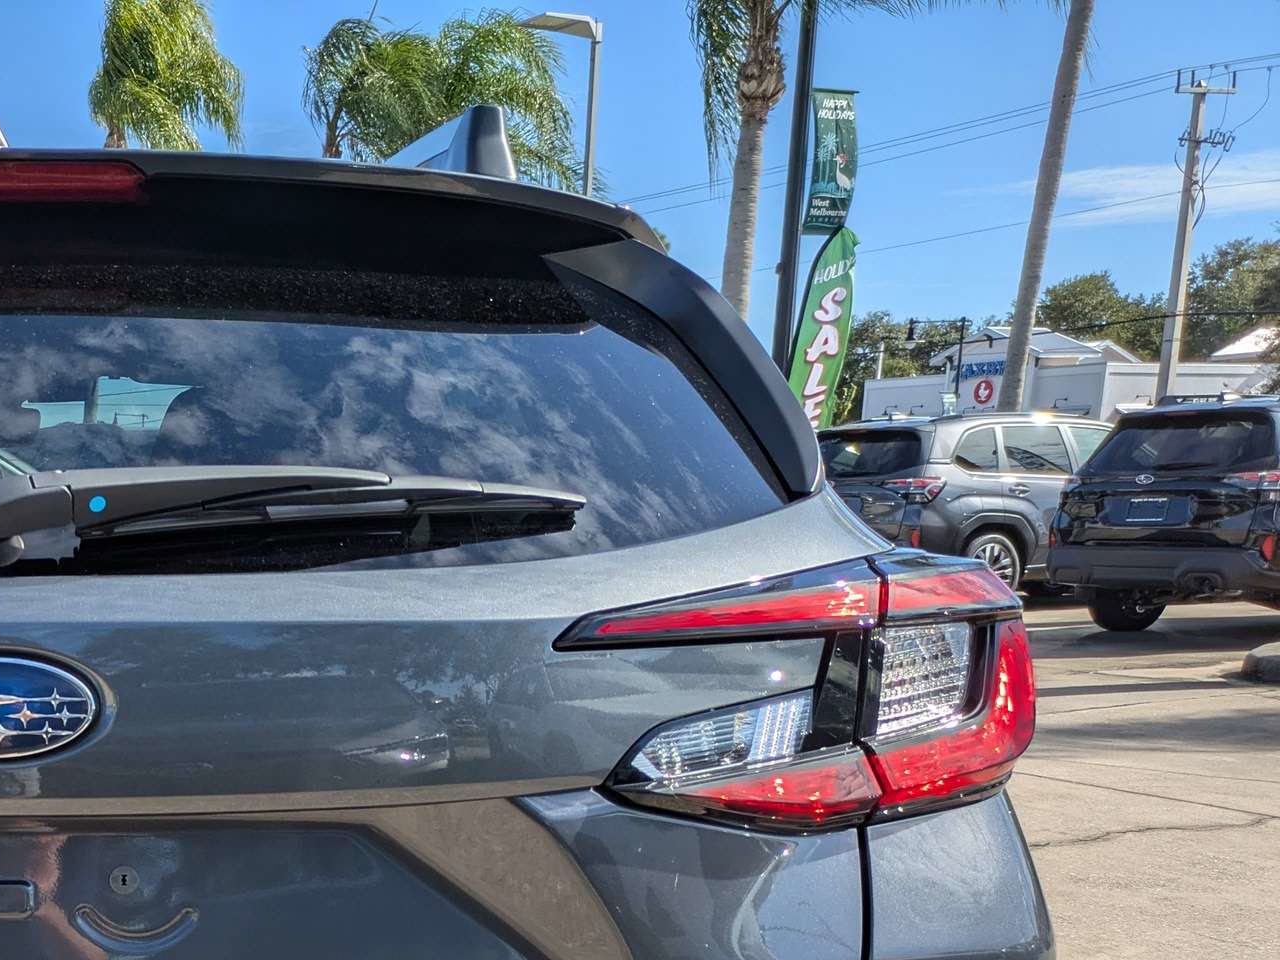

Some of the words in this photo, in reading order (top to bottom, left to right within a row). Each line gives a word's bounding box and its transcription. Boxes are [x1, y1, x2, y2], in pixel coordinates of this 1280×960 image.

[822, 98, 848, 109] HAPPY
[817, 109, 855, 121] HOLIDAYS
[811, 198, 830, 208] West
[809, 208, 847, 217] Melbourne
[803, 287, 847, 427] SALE
